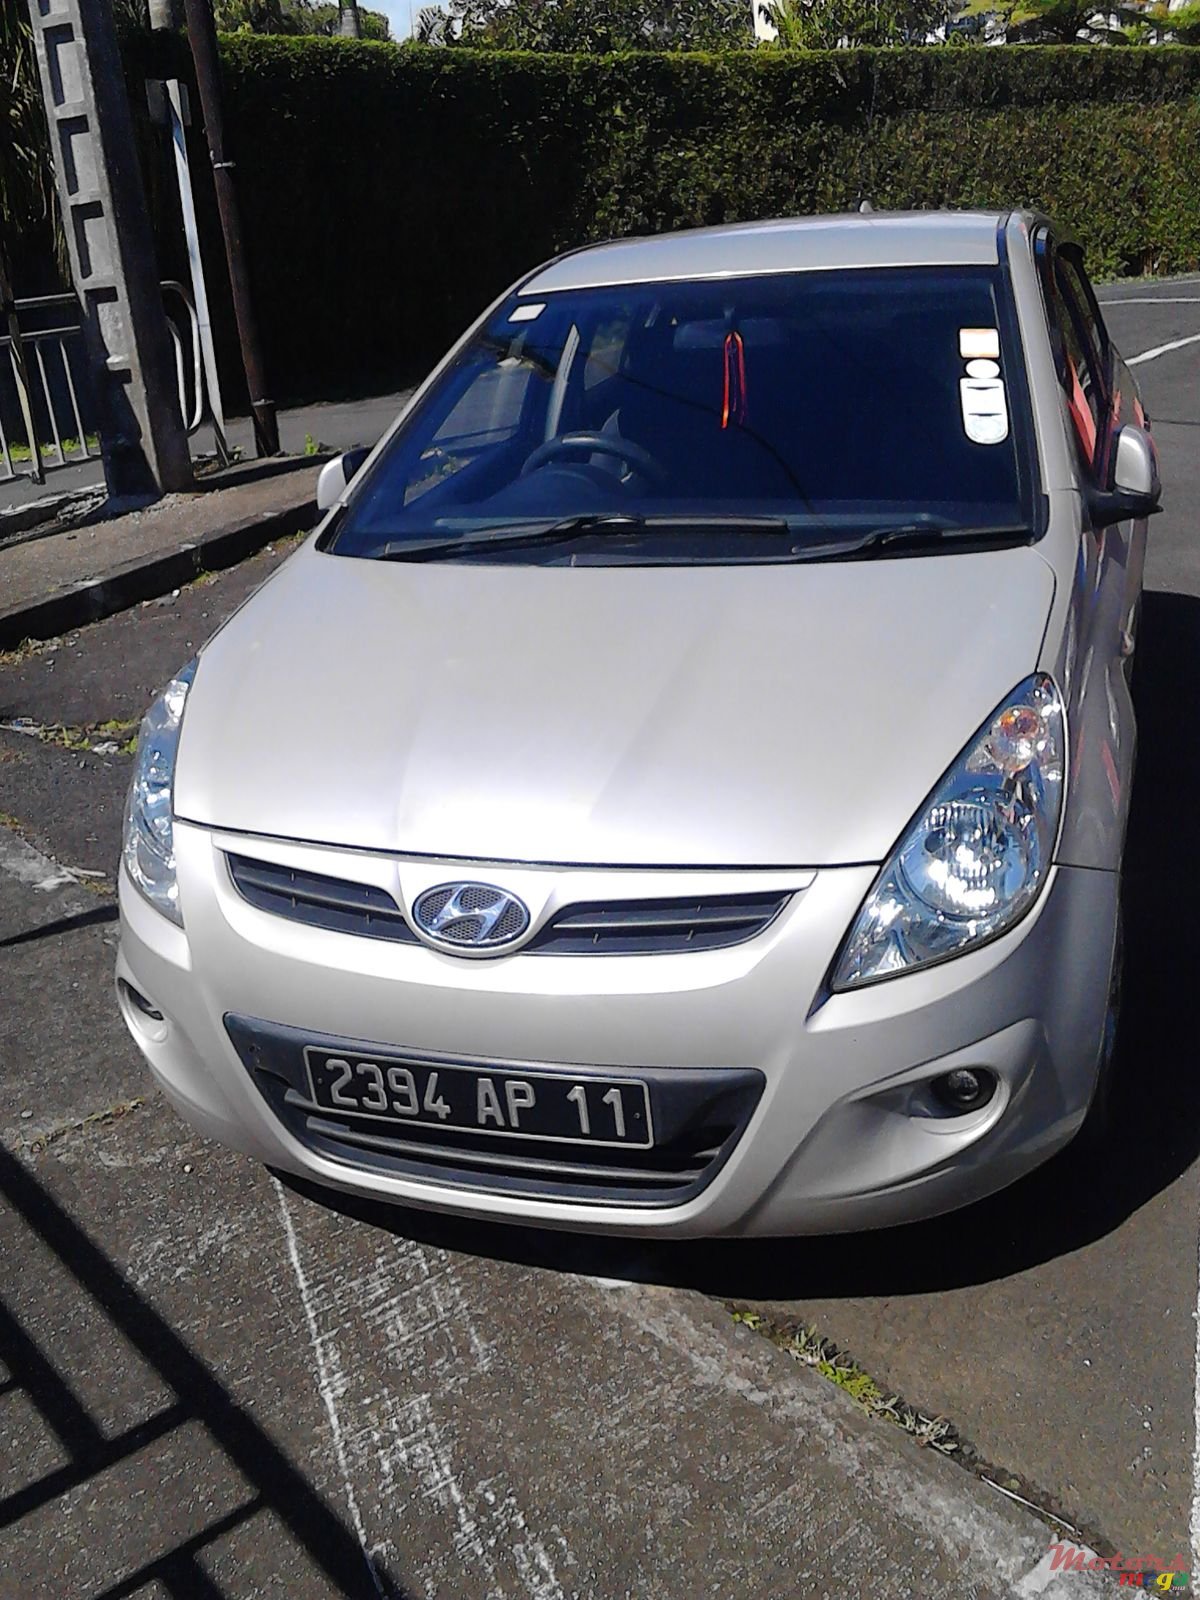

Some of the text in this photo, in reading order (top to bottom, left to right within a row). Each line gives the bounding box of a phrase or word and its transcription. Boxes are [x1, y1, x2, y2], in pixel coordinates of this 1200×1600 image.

[325, 1058, 626, 1137] 2394 AP 11
